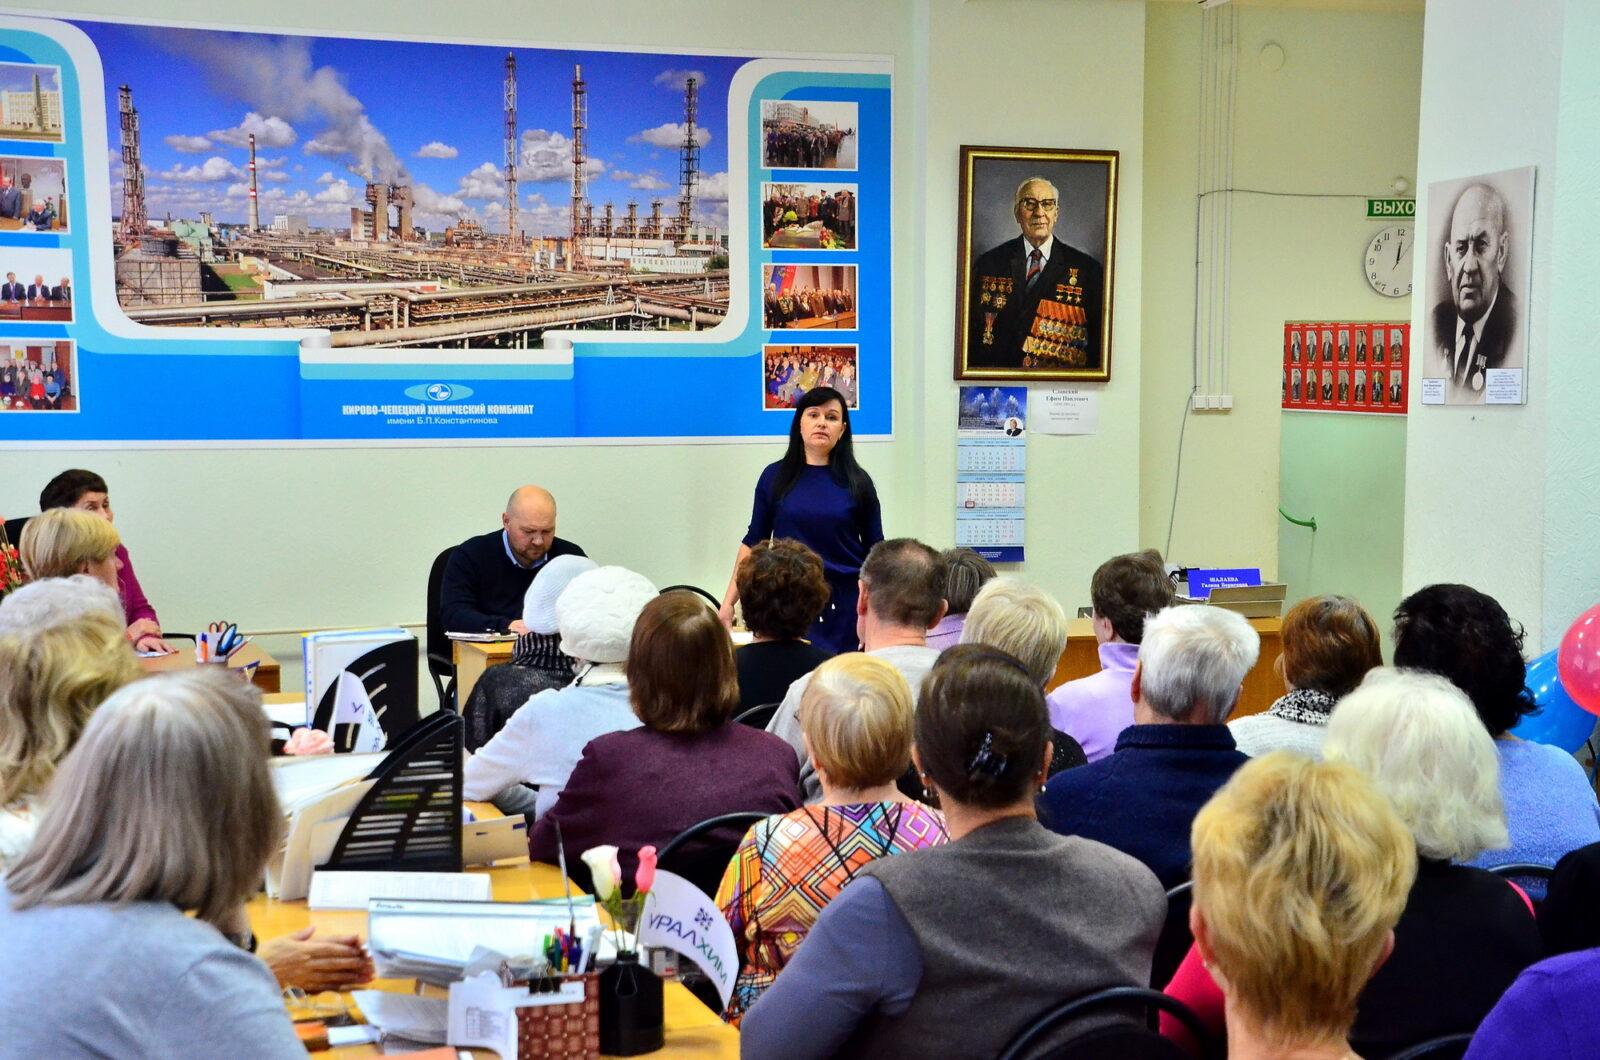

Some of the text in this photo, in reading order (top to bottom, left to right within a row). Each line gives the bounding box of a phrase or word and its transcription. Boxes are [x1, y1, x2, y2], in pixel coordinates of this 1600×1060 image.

[1373, 201, 1415, 215] ВЫХО
[1397, 228, 1406, 237] 12
[1384, 233, 1390, 241] 11
[1374, 244, 1382, 252] 10
[1371, 272, 1377, 280] 8
[1381, 284, 1386, 292] 7
[342, 403, 534, 416] КИРОВО-ЧЕПЕЦКИЙ ХИМИЧЕСКИЙ КОМБИНАТ
[649, 912, 728, 985] УРАЛХИМ
